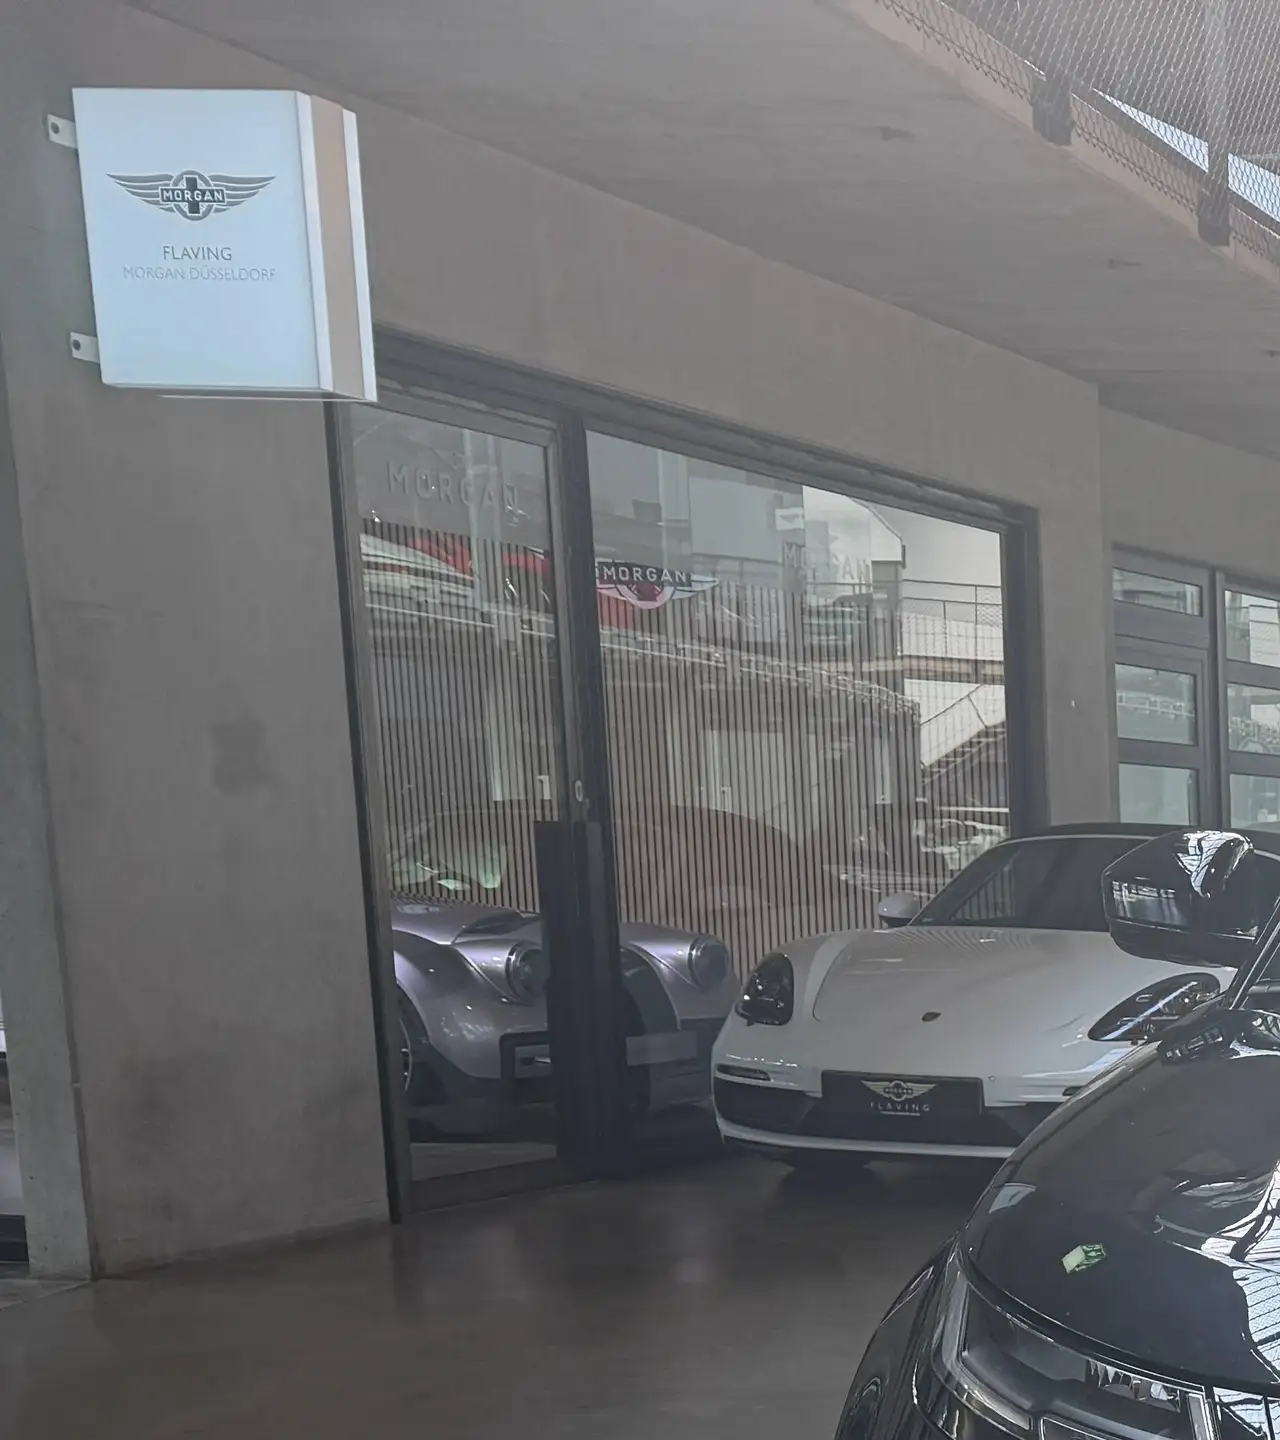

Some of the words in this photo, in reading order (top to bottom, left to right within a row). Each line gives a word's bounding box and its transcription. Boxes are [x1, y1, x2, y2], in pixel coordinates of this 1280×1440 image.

[162, 190, 224, 201] MORGAN
[162, 245, 232, 261] FLAVING
[123, 265, 185, 280] MORGAN
[189, 264, 276, 281] DÜSSELDORF
[602, 564, 687, 583] MORGAN
[870, 1101, 930, 1111] FLAVING
